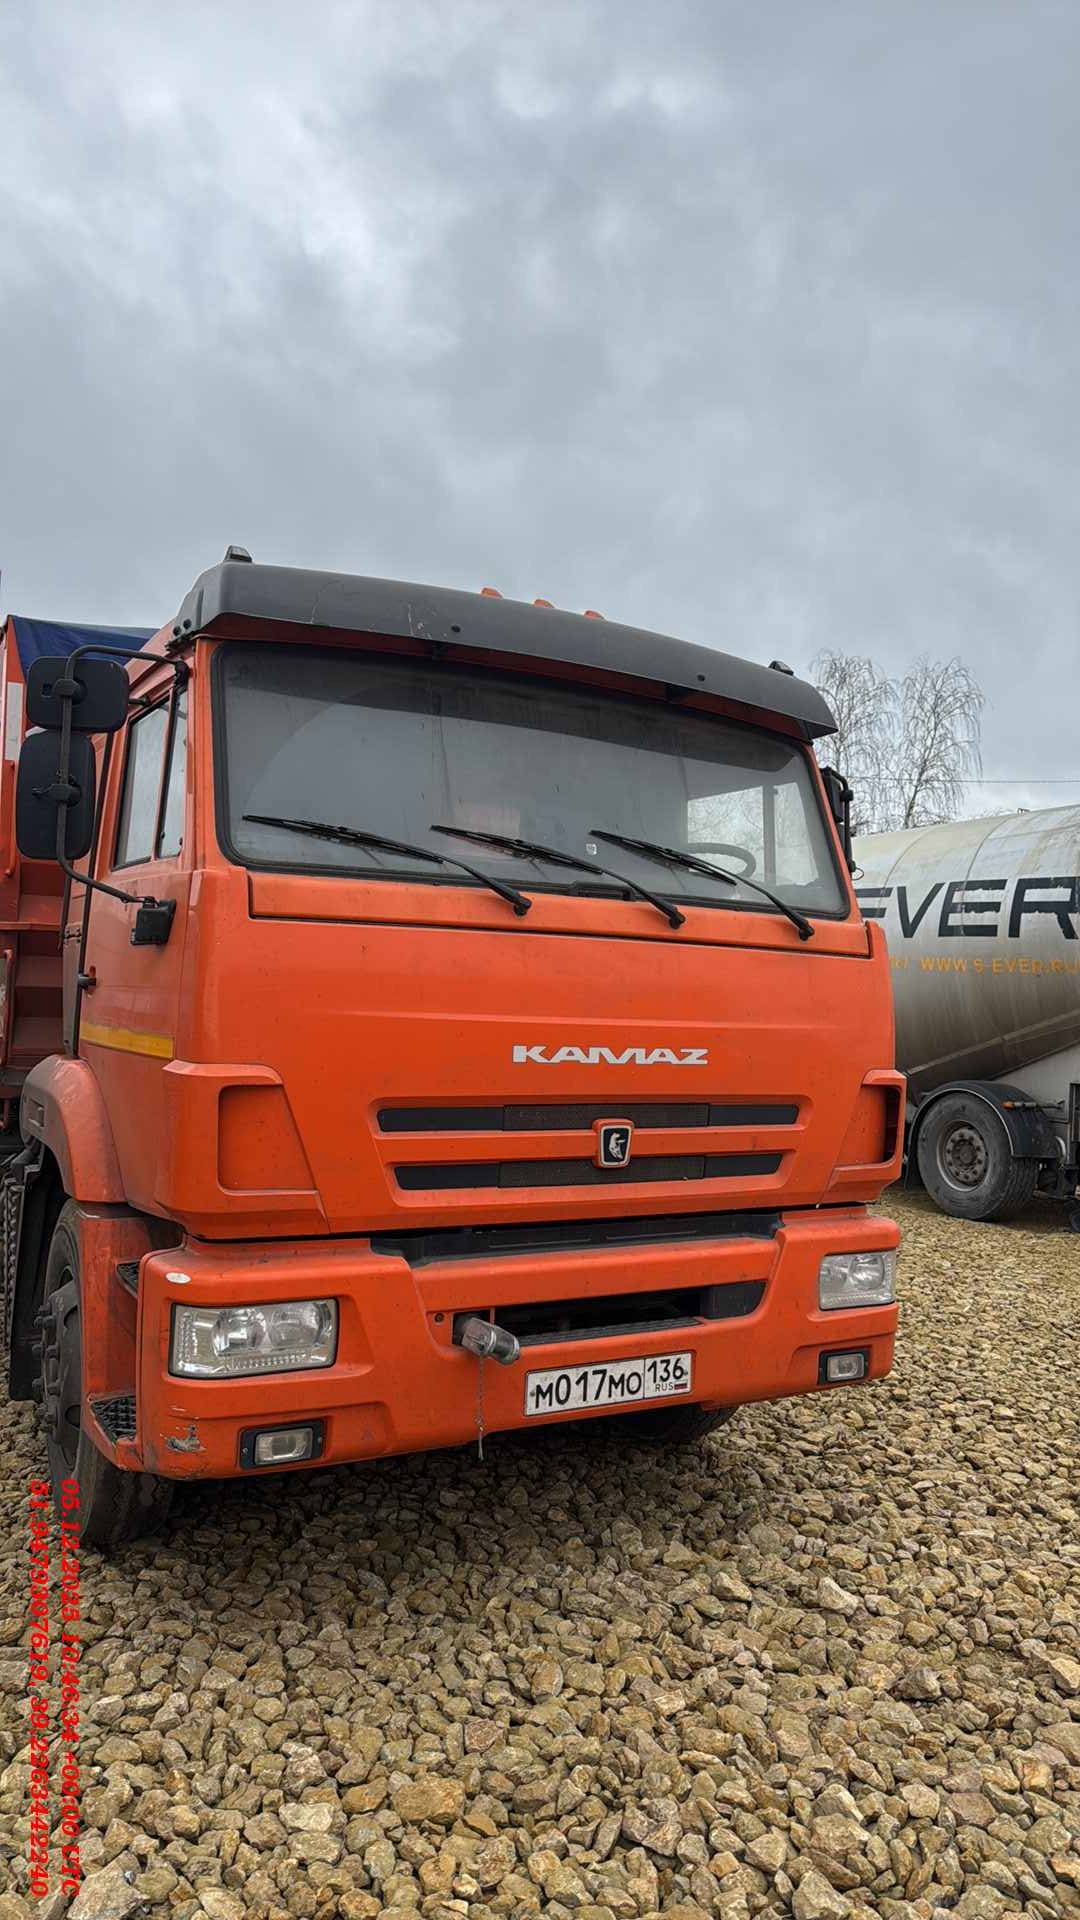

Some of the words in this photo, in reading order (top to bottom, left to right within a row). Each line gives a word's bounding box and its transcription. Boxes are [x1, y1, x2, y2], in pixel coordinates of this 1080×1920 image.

[512, 1045, 709, 1065] KAMAZ
[535, 1368, 642, 1409] M017MO
[647, 1357, 685, 1384] 136
[655, 1382, 674, 1393] RUS
